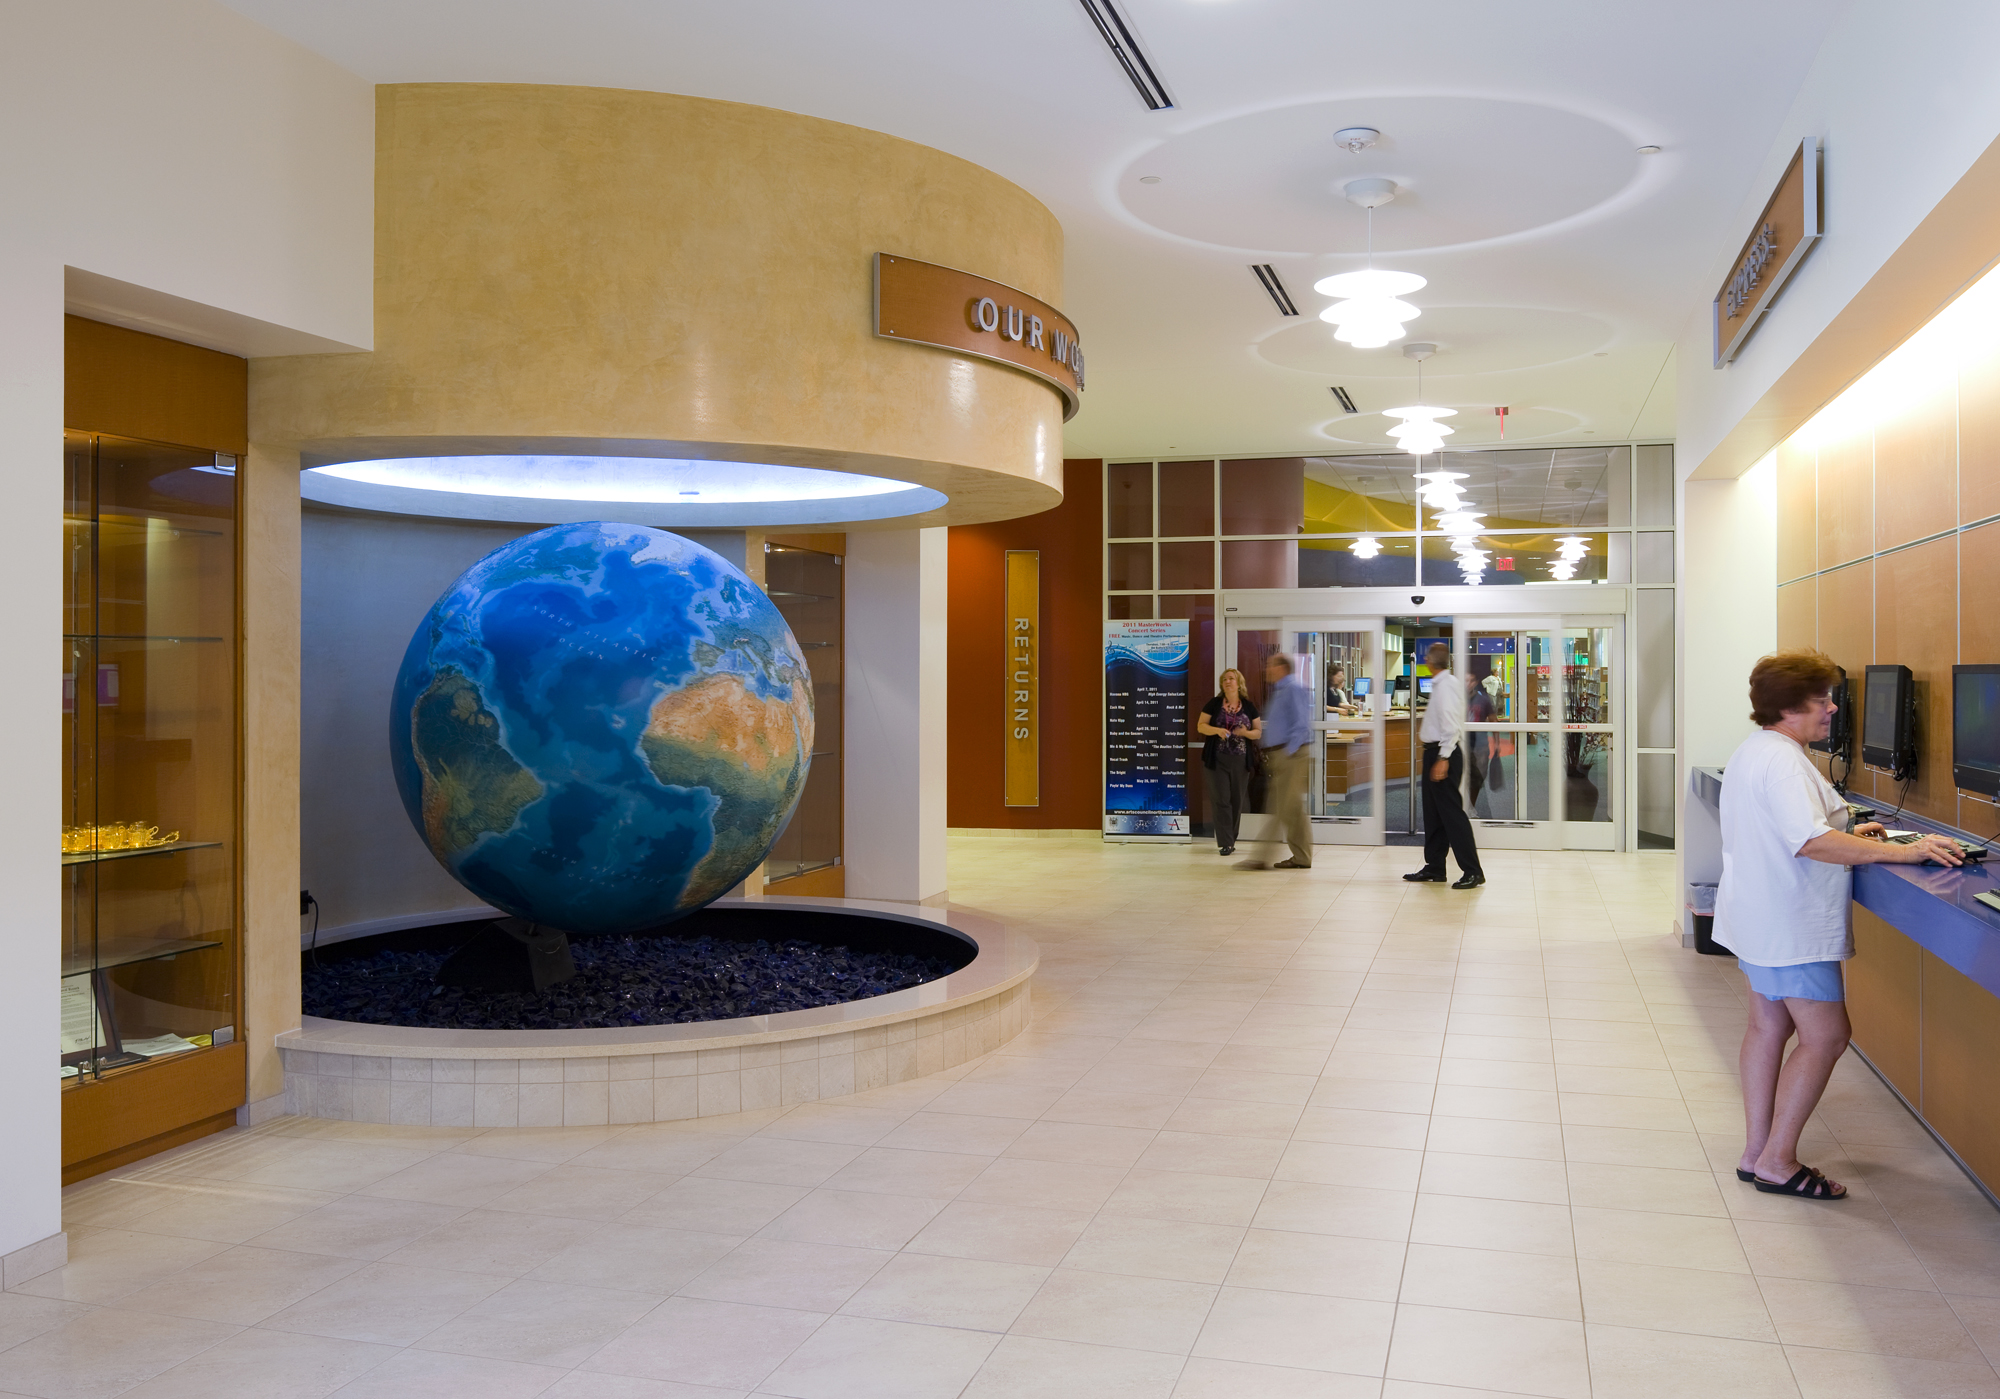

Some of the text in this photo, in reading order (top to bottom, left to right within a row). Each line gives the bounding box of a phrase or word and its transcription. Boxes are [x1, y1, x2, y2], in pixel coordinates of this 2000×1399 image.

[977, 297, 1044, 352] OUR
[1499, 558, 1513, 570] EXIT
[559, 637, 604, 660] OCEAN
[584, 630, 657, 662] ATLANTIC
[1014, 618, 1029, 740] RETURNS
